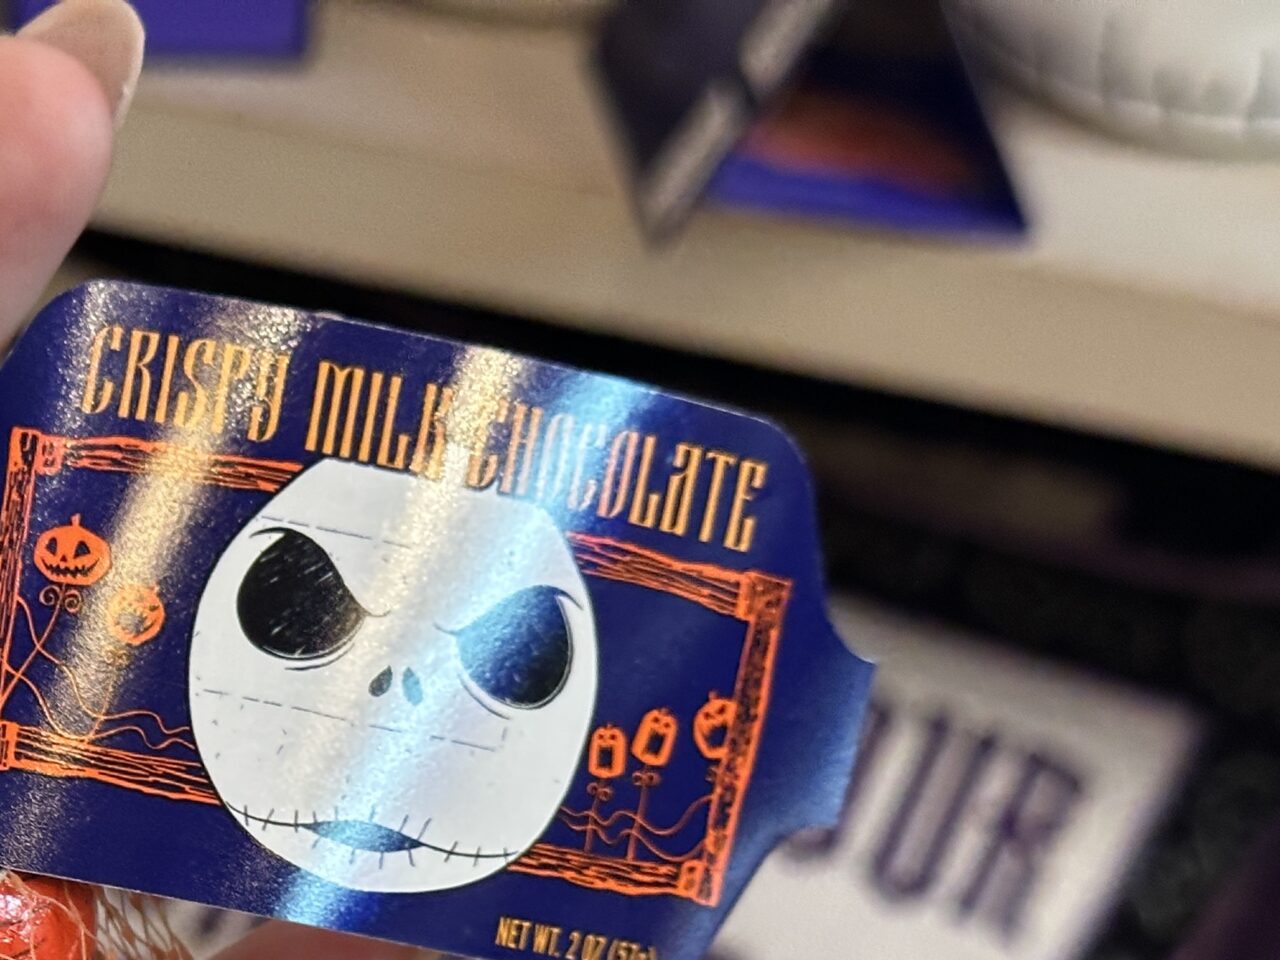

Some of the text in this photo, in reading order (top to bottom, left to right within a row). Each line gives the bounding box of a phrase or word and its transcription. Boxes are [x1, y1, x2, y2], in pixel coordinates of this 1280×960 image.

[81, 323, 769, 553] CRISPY MILK CHOCOLATE
[495, 916, 532, 950] NET
[532, 923, 562, 958] WT.
[565, 930, 582, 960] 2
